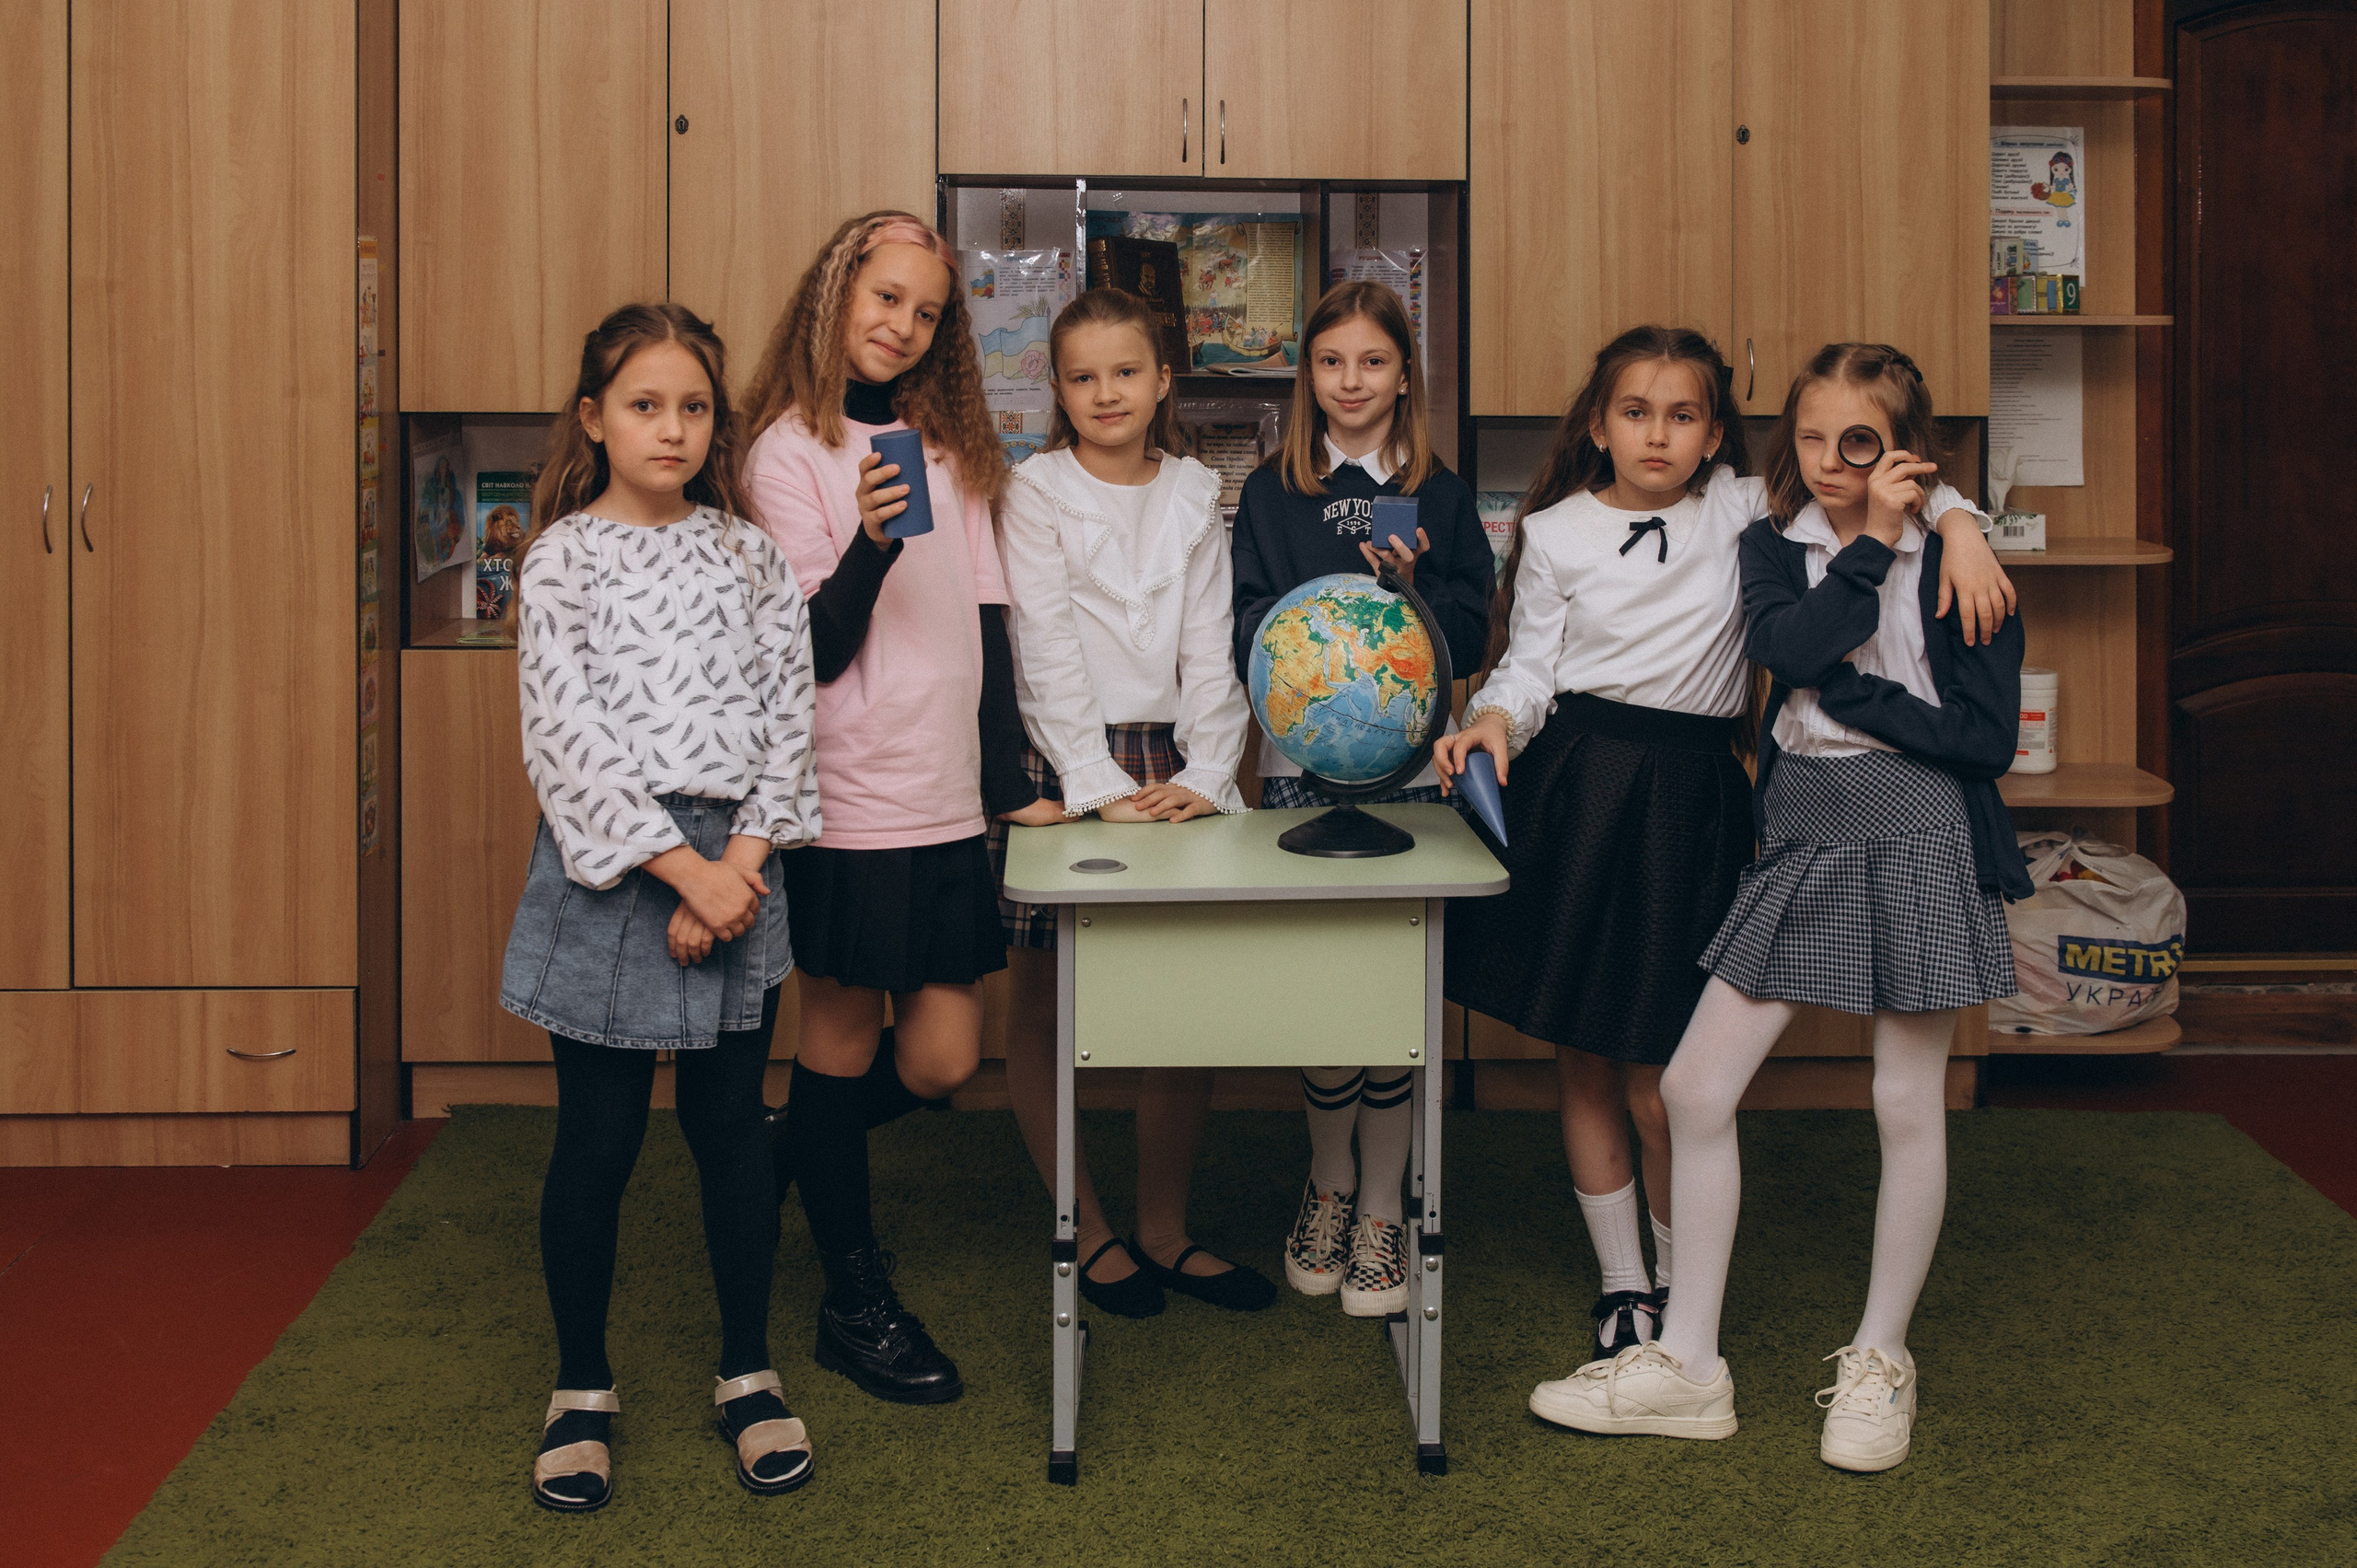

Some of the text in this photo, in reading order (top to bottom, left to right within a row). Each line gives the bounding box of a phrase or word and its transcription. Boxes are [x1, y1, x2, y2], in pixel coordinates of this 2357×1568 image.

[1323, 498, 1373, 521] NEW YO
[1337, 526, 1372, 535] EST
[1482, 521, 1517, 533] РЕСТ
[483, 558, 513, 572] ХТО
[2066, 981, 2159, 1008] УКРА
